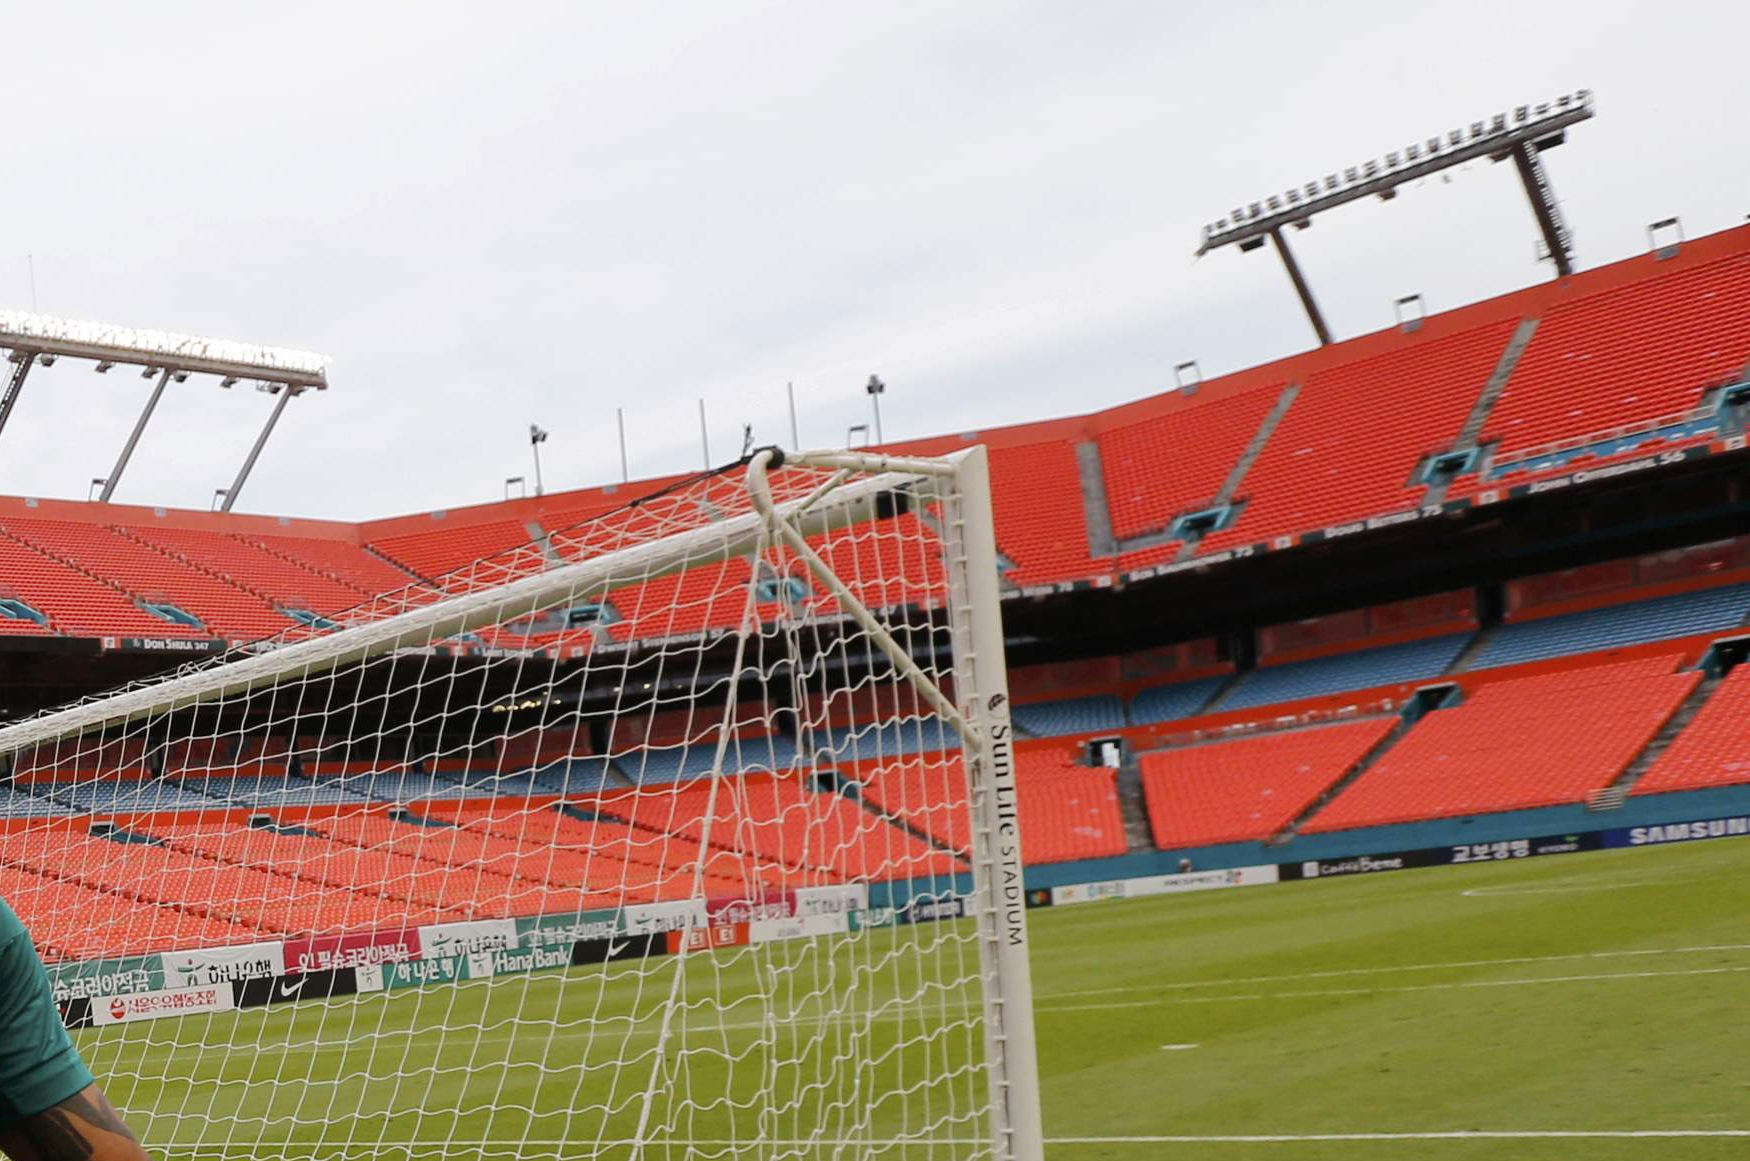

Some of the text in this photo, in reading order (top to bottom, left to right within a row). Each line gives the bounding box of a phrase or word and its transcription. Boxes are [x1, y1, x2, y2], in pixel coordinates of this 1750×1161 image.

[991, 724, 1023, 946] Sun Life STADIUM
[1630, 817, 1750, 844] SAMSUN
[497, 945, 569, 973] Hana Bank
